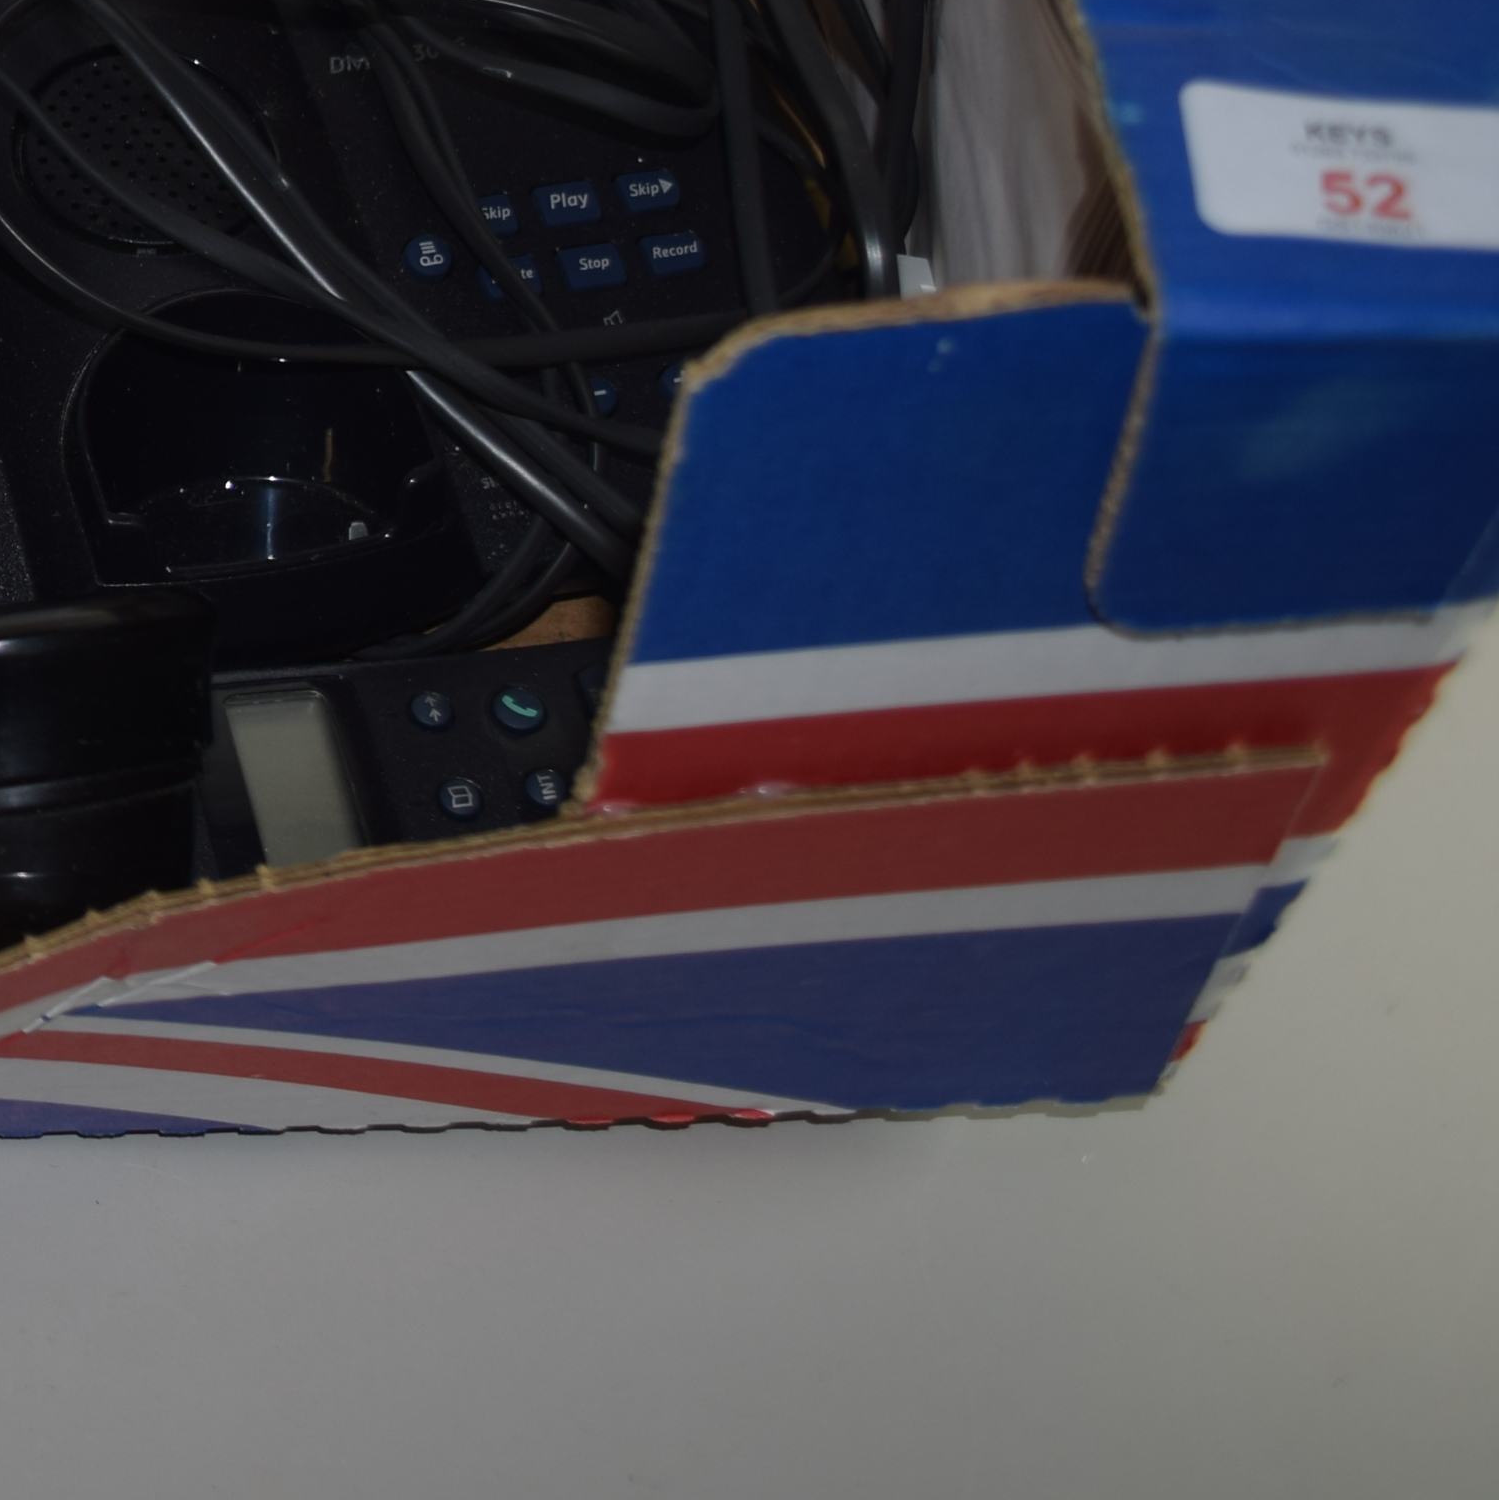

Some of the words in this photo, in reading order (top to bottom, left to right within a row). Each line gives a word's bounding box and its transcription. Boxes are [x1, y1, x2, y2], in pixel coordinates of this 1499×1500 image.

[1305, 123, 1390, 146] KEYS
[549, 190, 589, 211] Play
[629, 181, 660, 200] Skip
[1322, 172, 1410, 219] 52
[651, 241, 698, 260] Record
[578, 255, 610, 273] Stop
[537, 774, 557, 800] INT
